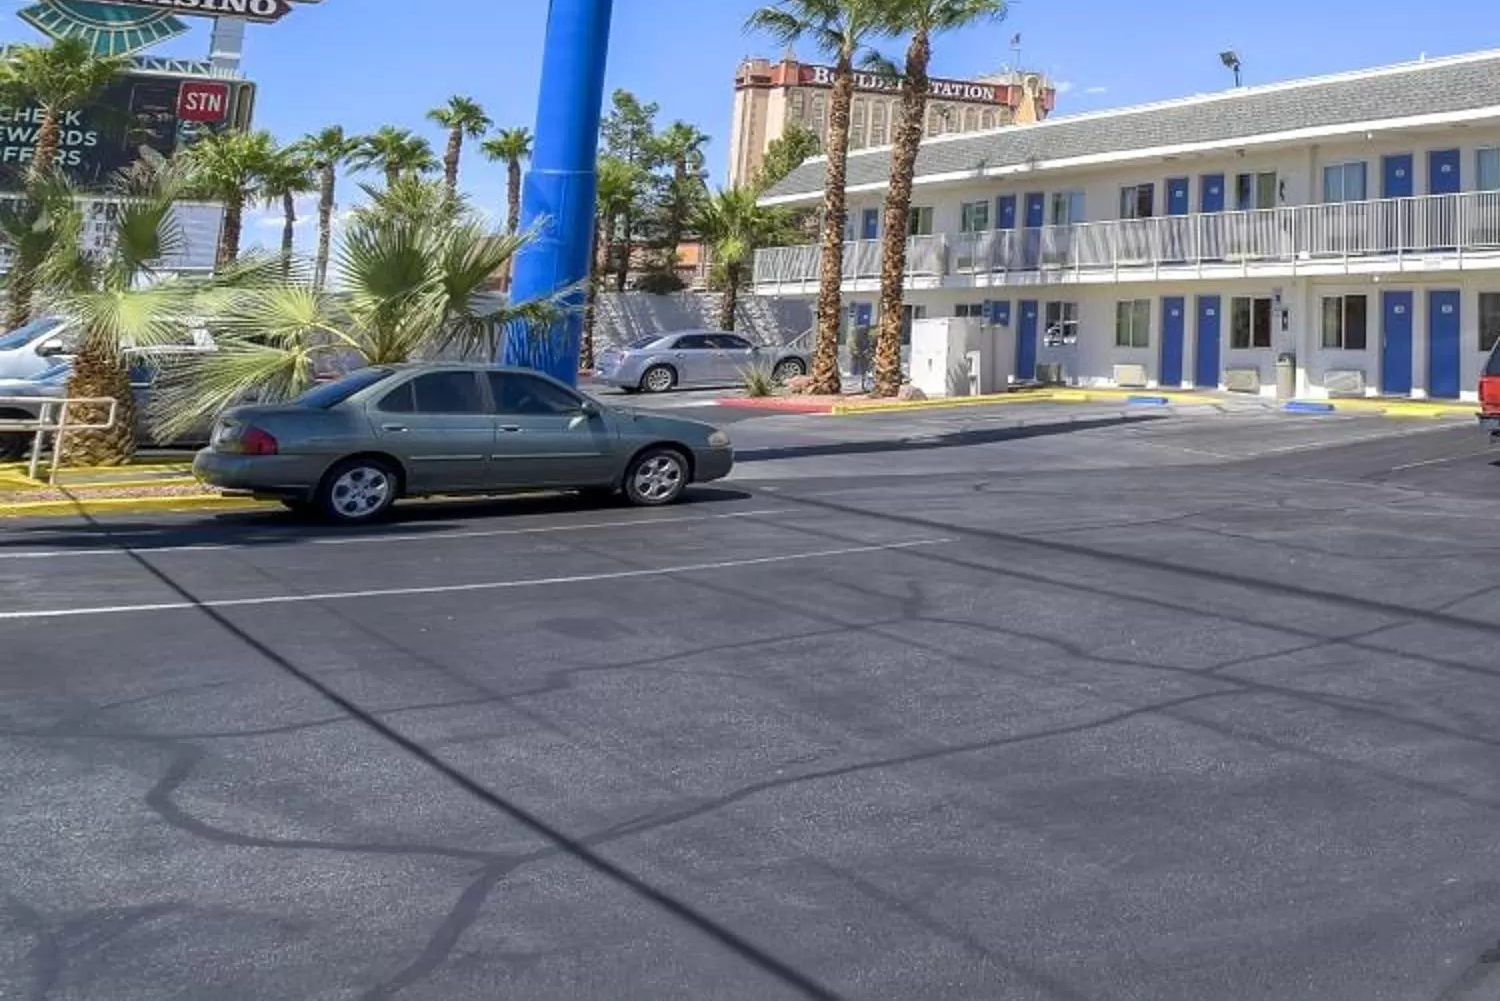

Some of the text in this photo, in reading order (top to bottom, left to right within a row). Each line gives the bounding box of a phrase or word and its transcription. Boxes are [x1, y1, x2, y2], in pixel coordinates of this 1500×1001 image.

[928, 80, 996, 100] TATION
[184, 91, 222, 112] STN
[0, 106, 81, 126] CHEK
[0, 146, 82, 167] FFRS
